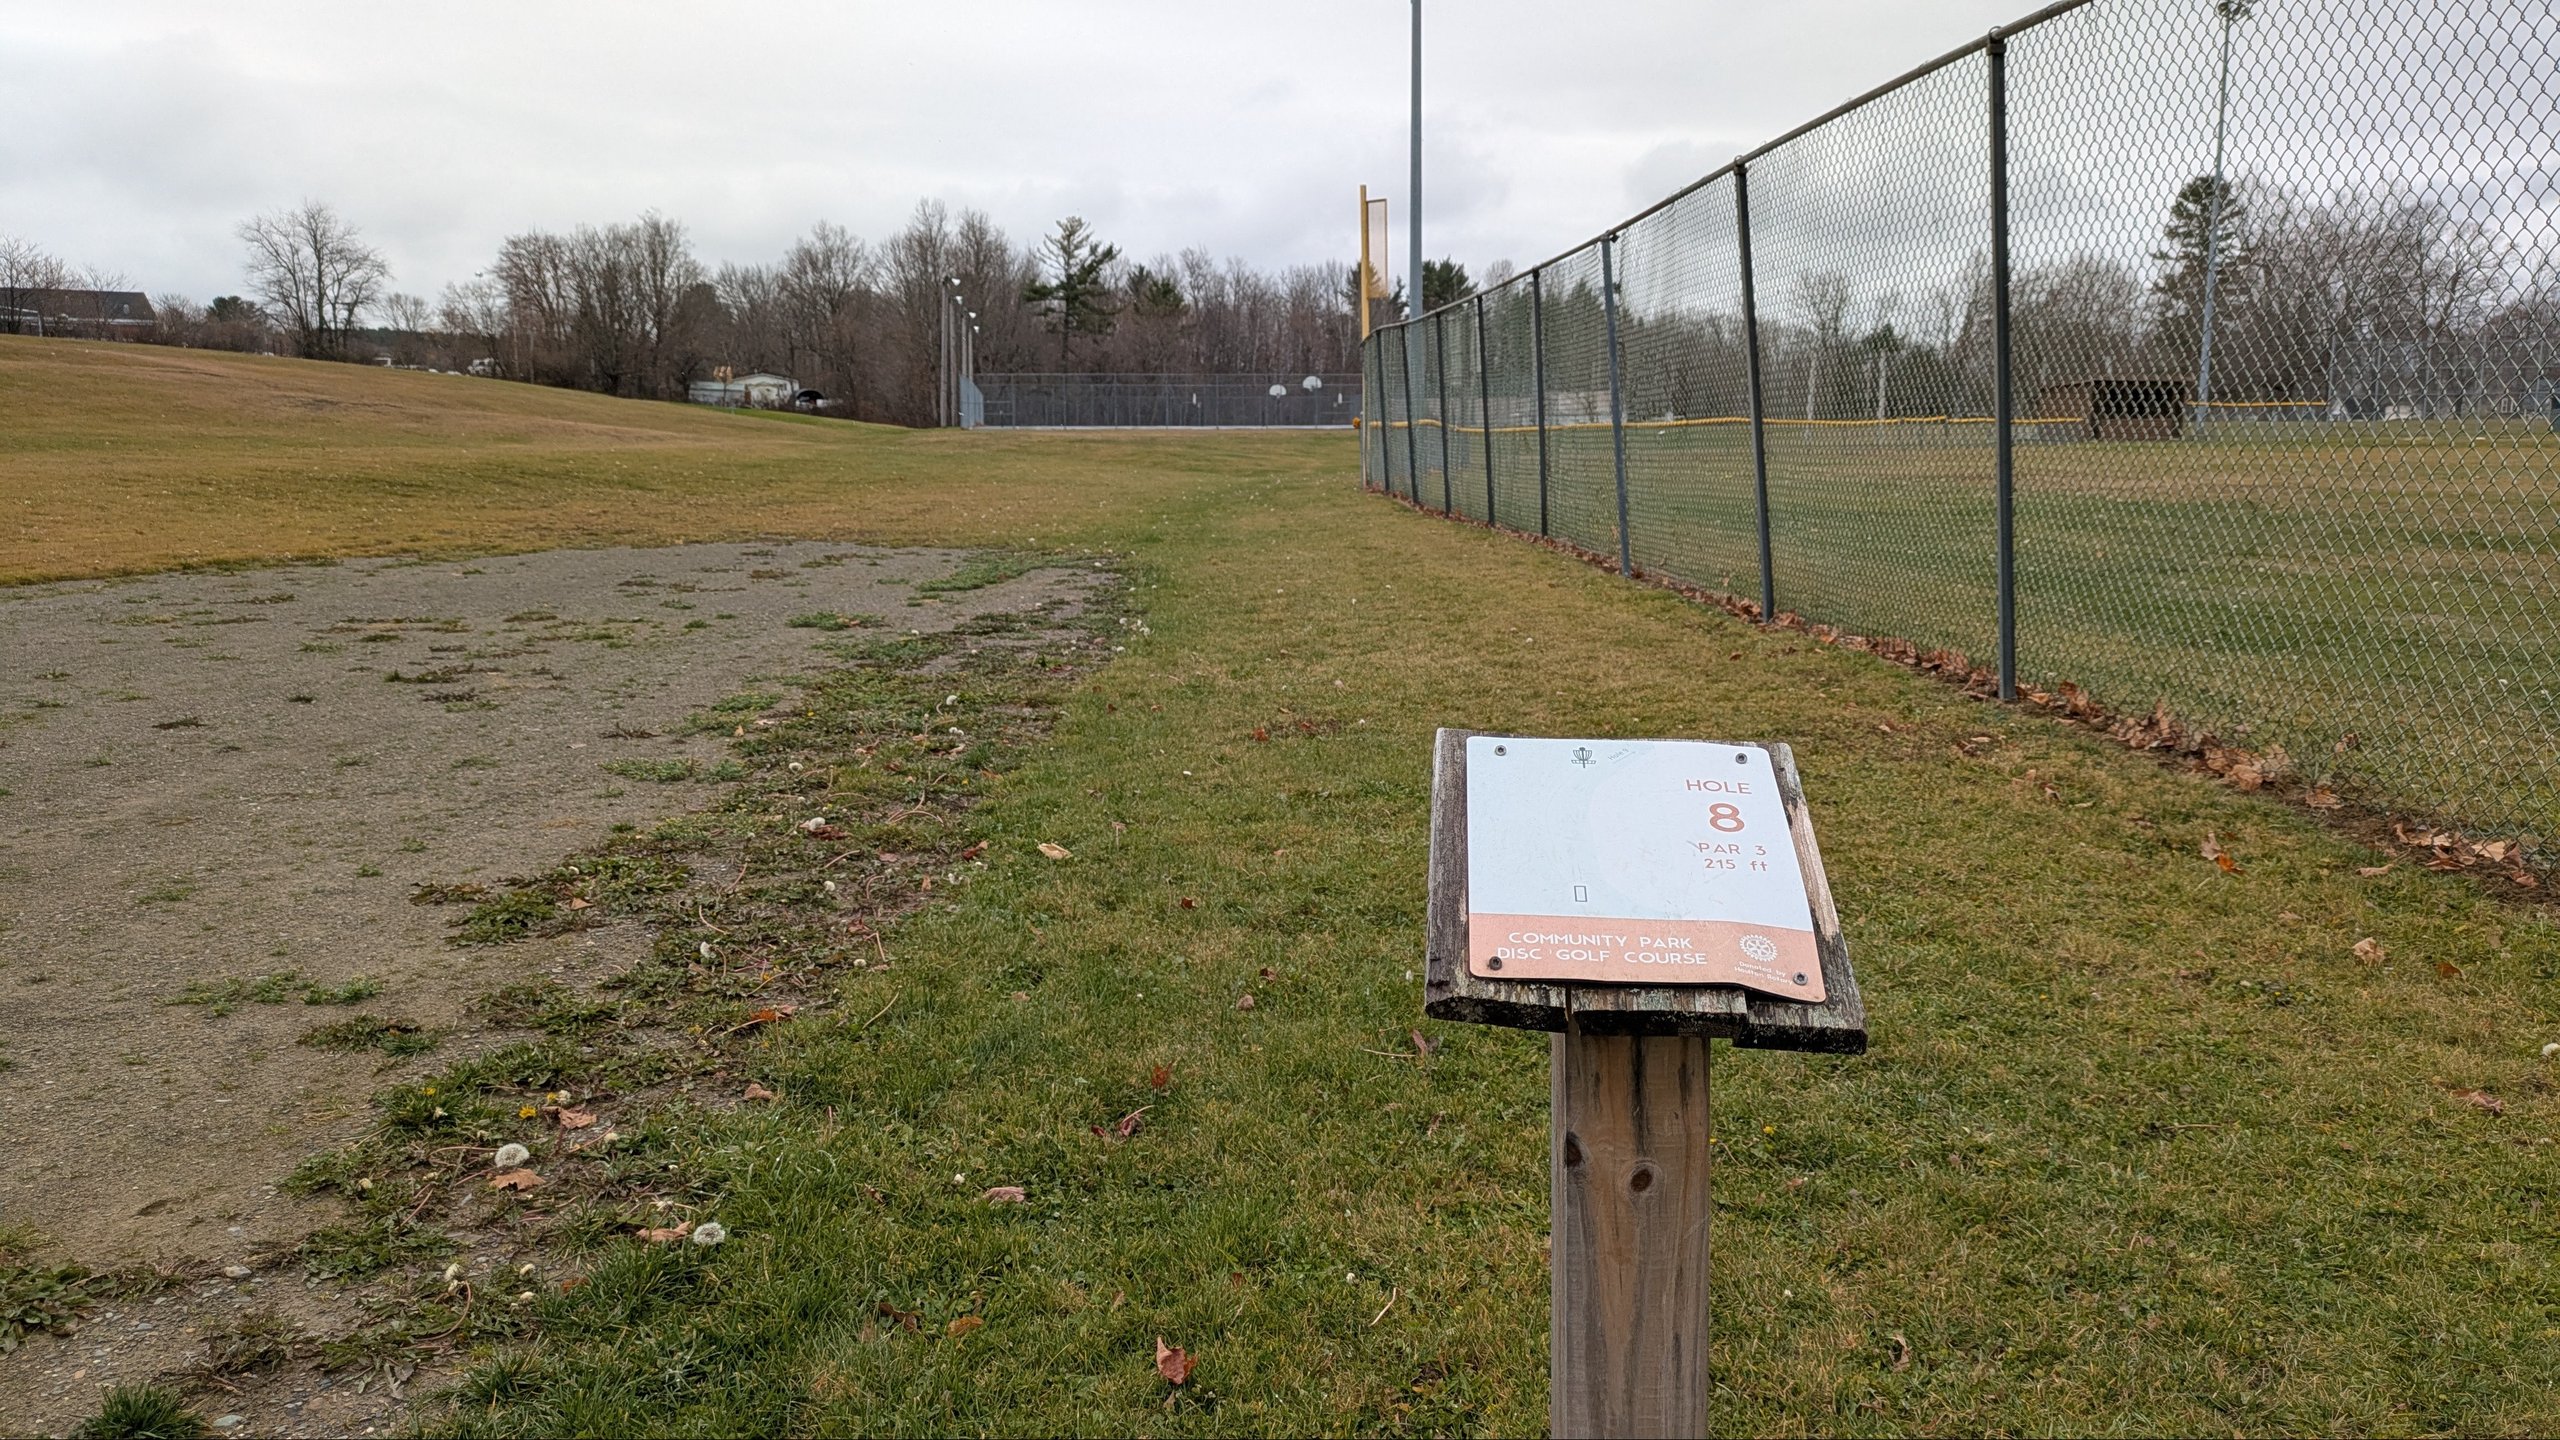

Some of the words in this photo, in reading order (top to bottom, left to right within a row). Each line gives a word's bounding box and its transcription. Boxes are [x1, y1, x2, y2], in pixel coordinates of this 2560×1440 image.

[1686, 779, 1752, 794] HOLE
[1709, 803, 1745, 832] 8
[1698, 842, 1741, 855] PAR
[1754, 845, 1767, 856] 3
[1704, 858, 1736, 870] 215
[1749, 860, 1768, 872] ft
[1508, 932, 1626, 948] COMMUNITY
[1639, 936, 1693, 950] PARK
[1497, 946, 1543, 960] DISC
[1556, 948, 1610, 963] GOLF
[1624, 951, 1708, 966] COURSE
[1738, 961, 1772, 973] Donated
[1776, 969, 1786, 978] by
[1767, 974, 1793, 985] Rotary
